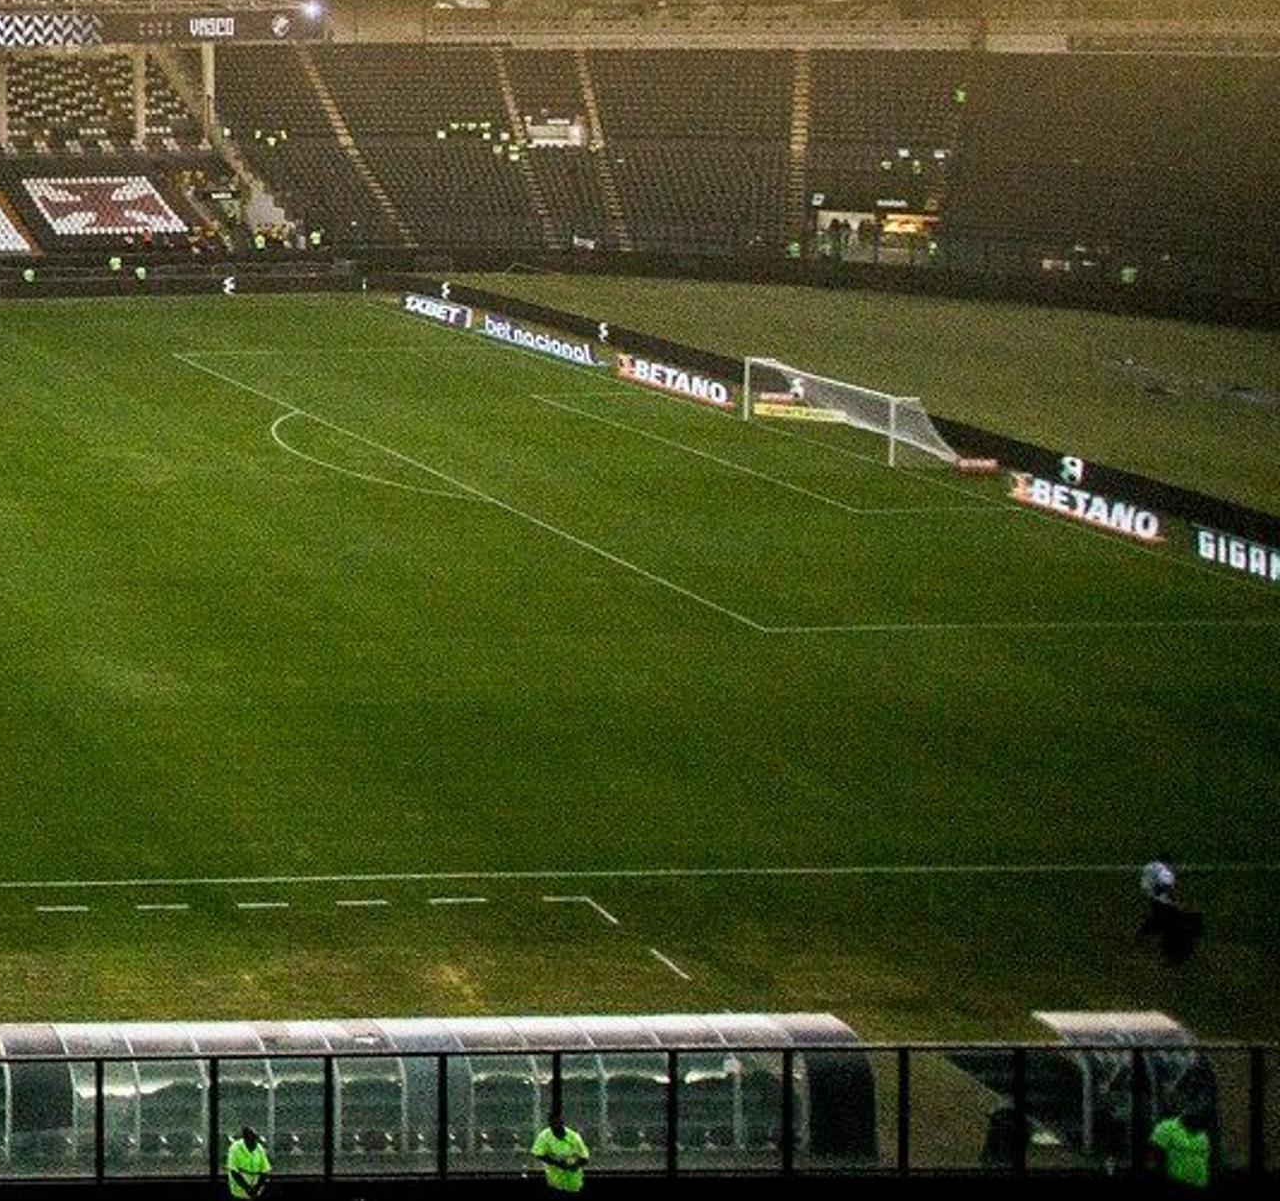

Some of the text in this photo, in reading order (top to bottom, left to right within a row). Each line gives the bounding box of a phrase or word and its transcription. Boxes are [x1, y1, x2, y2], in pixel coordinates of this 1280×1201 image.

[189, 17, 234, 37] VASCO
[634, 358, 729, 404] BETANO
[1030, 477, 1160, 540] BETANO
